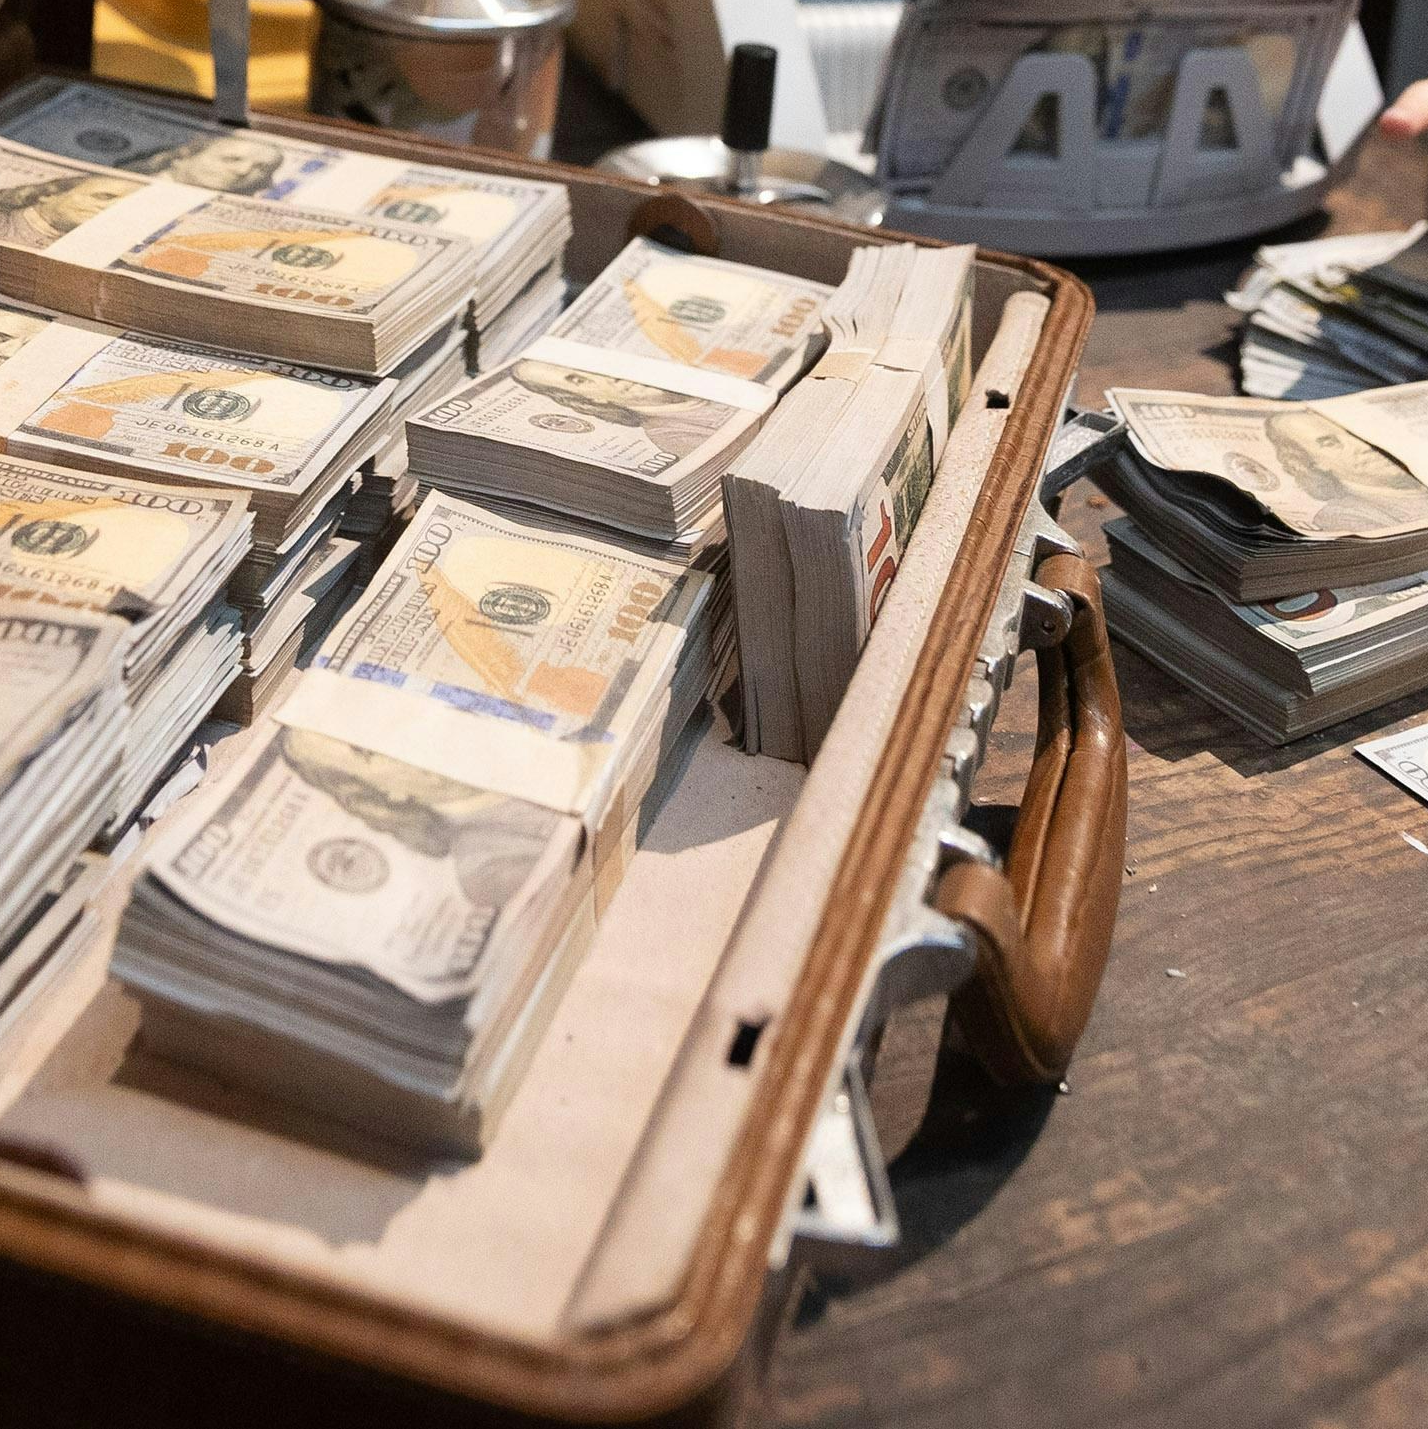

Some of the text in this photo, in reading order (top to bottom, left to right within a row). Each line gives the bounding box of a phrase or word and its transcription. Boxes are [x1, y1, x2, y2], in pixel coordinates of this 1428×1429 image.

[254, 283, 356, 307] 100
[270, 362, 355, 391] 100
[427, 399, 473, 424] 100
[162, 422, 265, 448] 06161268
[268, 442, 282, 452] A
[160, 441, 276, 474] 100
[637, 451, 678, 476] 100
[116, 485, 204, 517] 100
[405, 521, 453, 574] 100
[564, 581, 609, 637] 06161268
[606, 580, 666, 645] 100
[382, 605, 440, 671] PURPOSES
